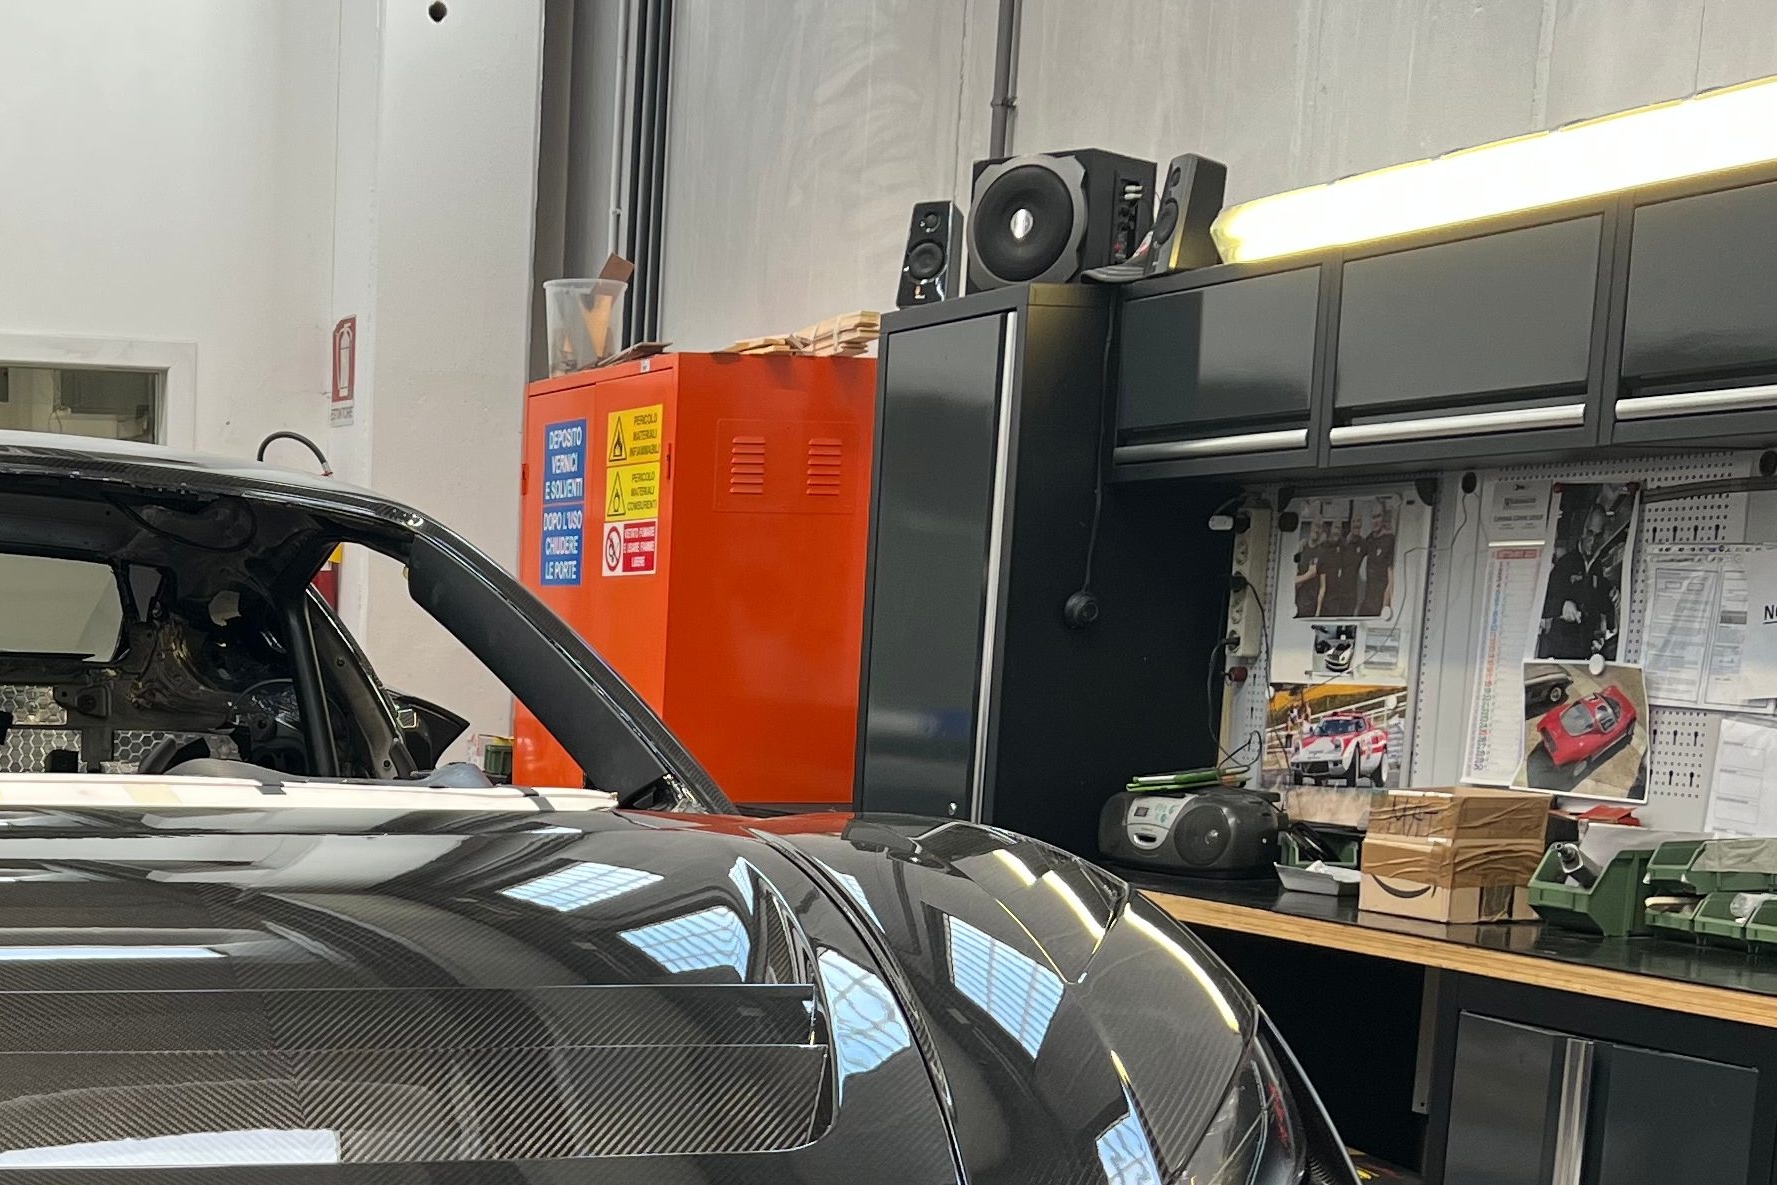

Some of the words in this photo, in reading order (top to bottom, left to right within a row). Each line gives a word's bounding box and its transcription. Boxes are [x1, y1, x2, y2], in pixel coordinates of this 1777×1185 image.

[549, 426, 583, 450] DEPOSITO
[552, 453, 578, 475] VERNICI
[545, 481, 551, 500] E
[551, 477, 583, 499] SOLVENTI
[543, 511, 562, 531] DOPO
[563, 510, 583, 530] L'USO
[545, 535, 579, 556] CHIUDERE
[545, 562, 554, 580] LE
[554, 560, 578, 580] PORTE
[1764, 604, 1777, 621] N
